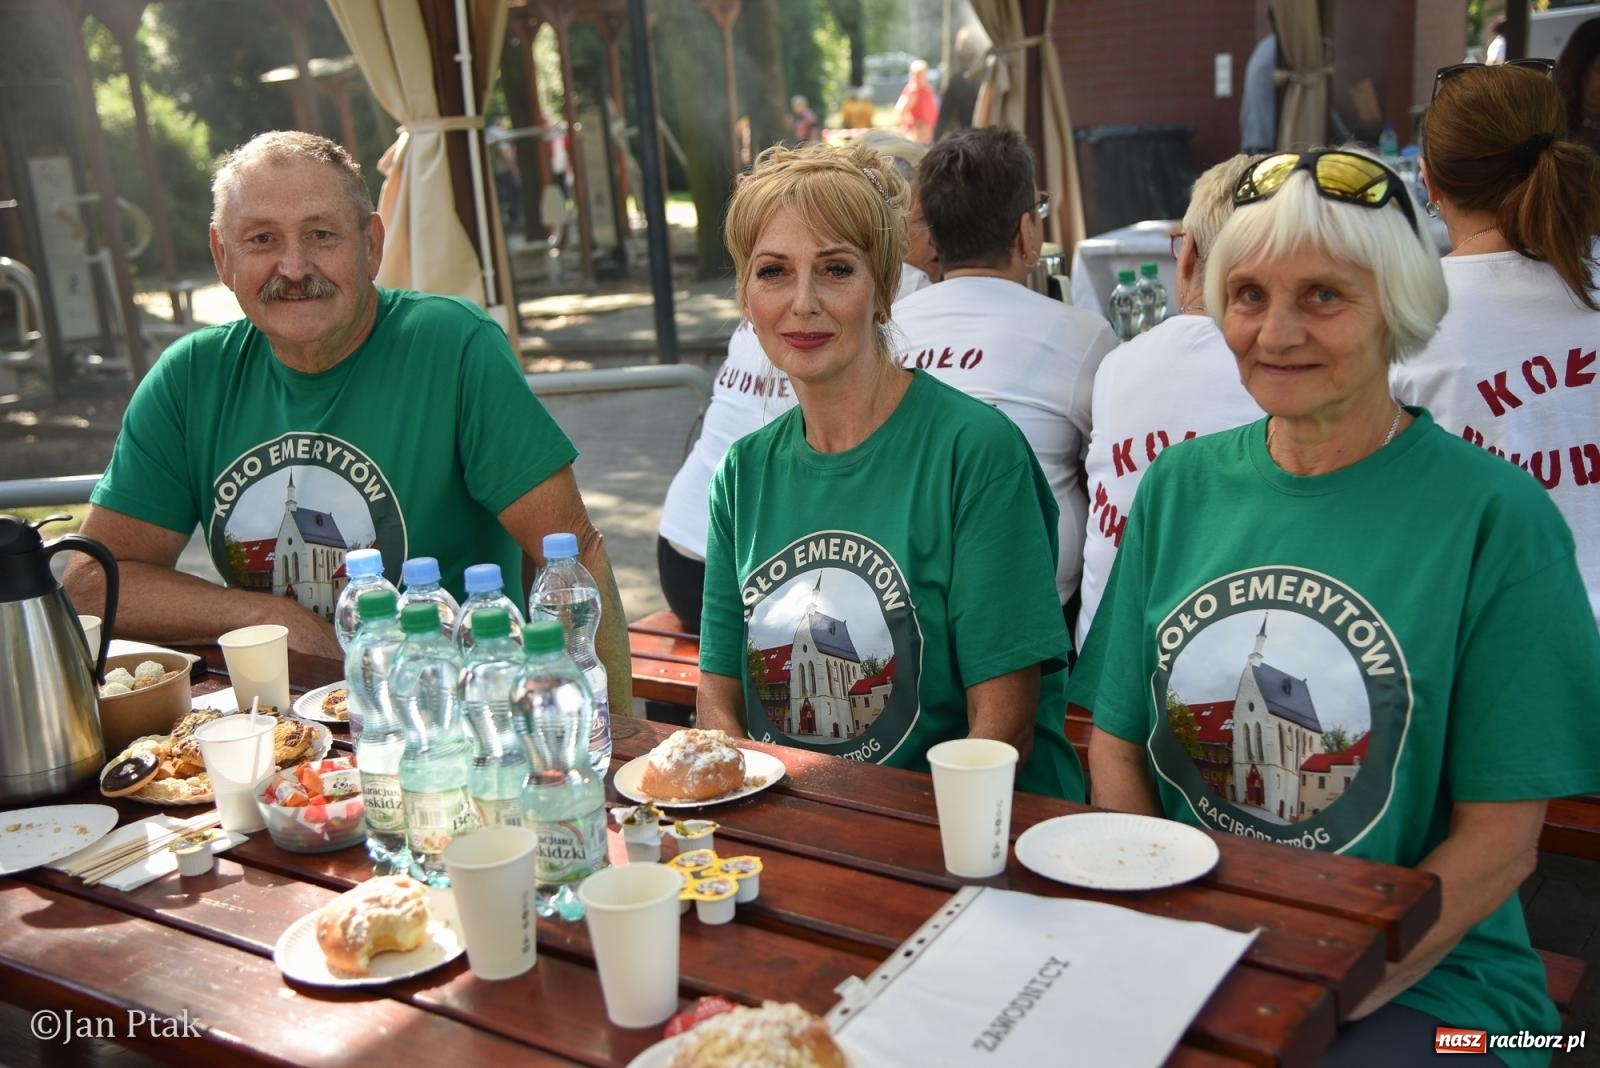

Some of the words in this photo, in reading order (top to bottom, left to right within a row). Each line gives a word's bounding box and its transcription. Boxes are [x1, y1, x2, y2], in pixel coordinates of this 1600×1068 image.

[214, 456, 262, 518] KOŁO
[268, 438, 387, 503] EMERYTÓW
[742, 559, 788, 622] OŁO
[793, 537, 906, 612] EMERYTÓW
[1228, 574, 1396, 677] EMERYTÓW
[972, 955, 1071, 1053] ZAWODNICY
